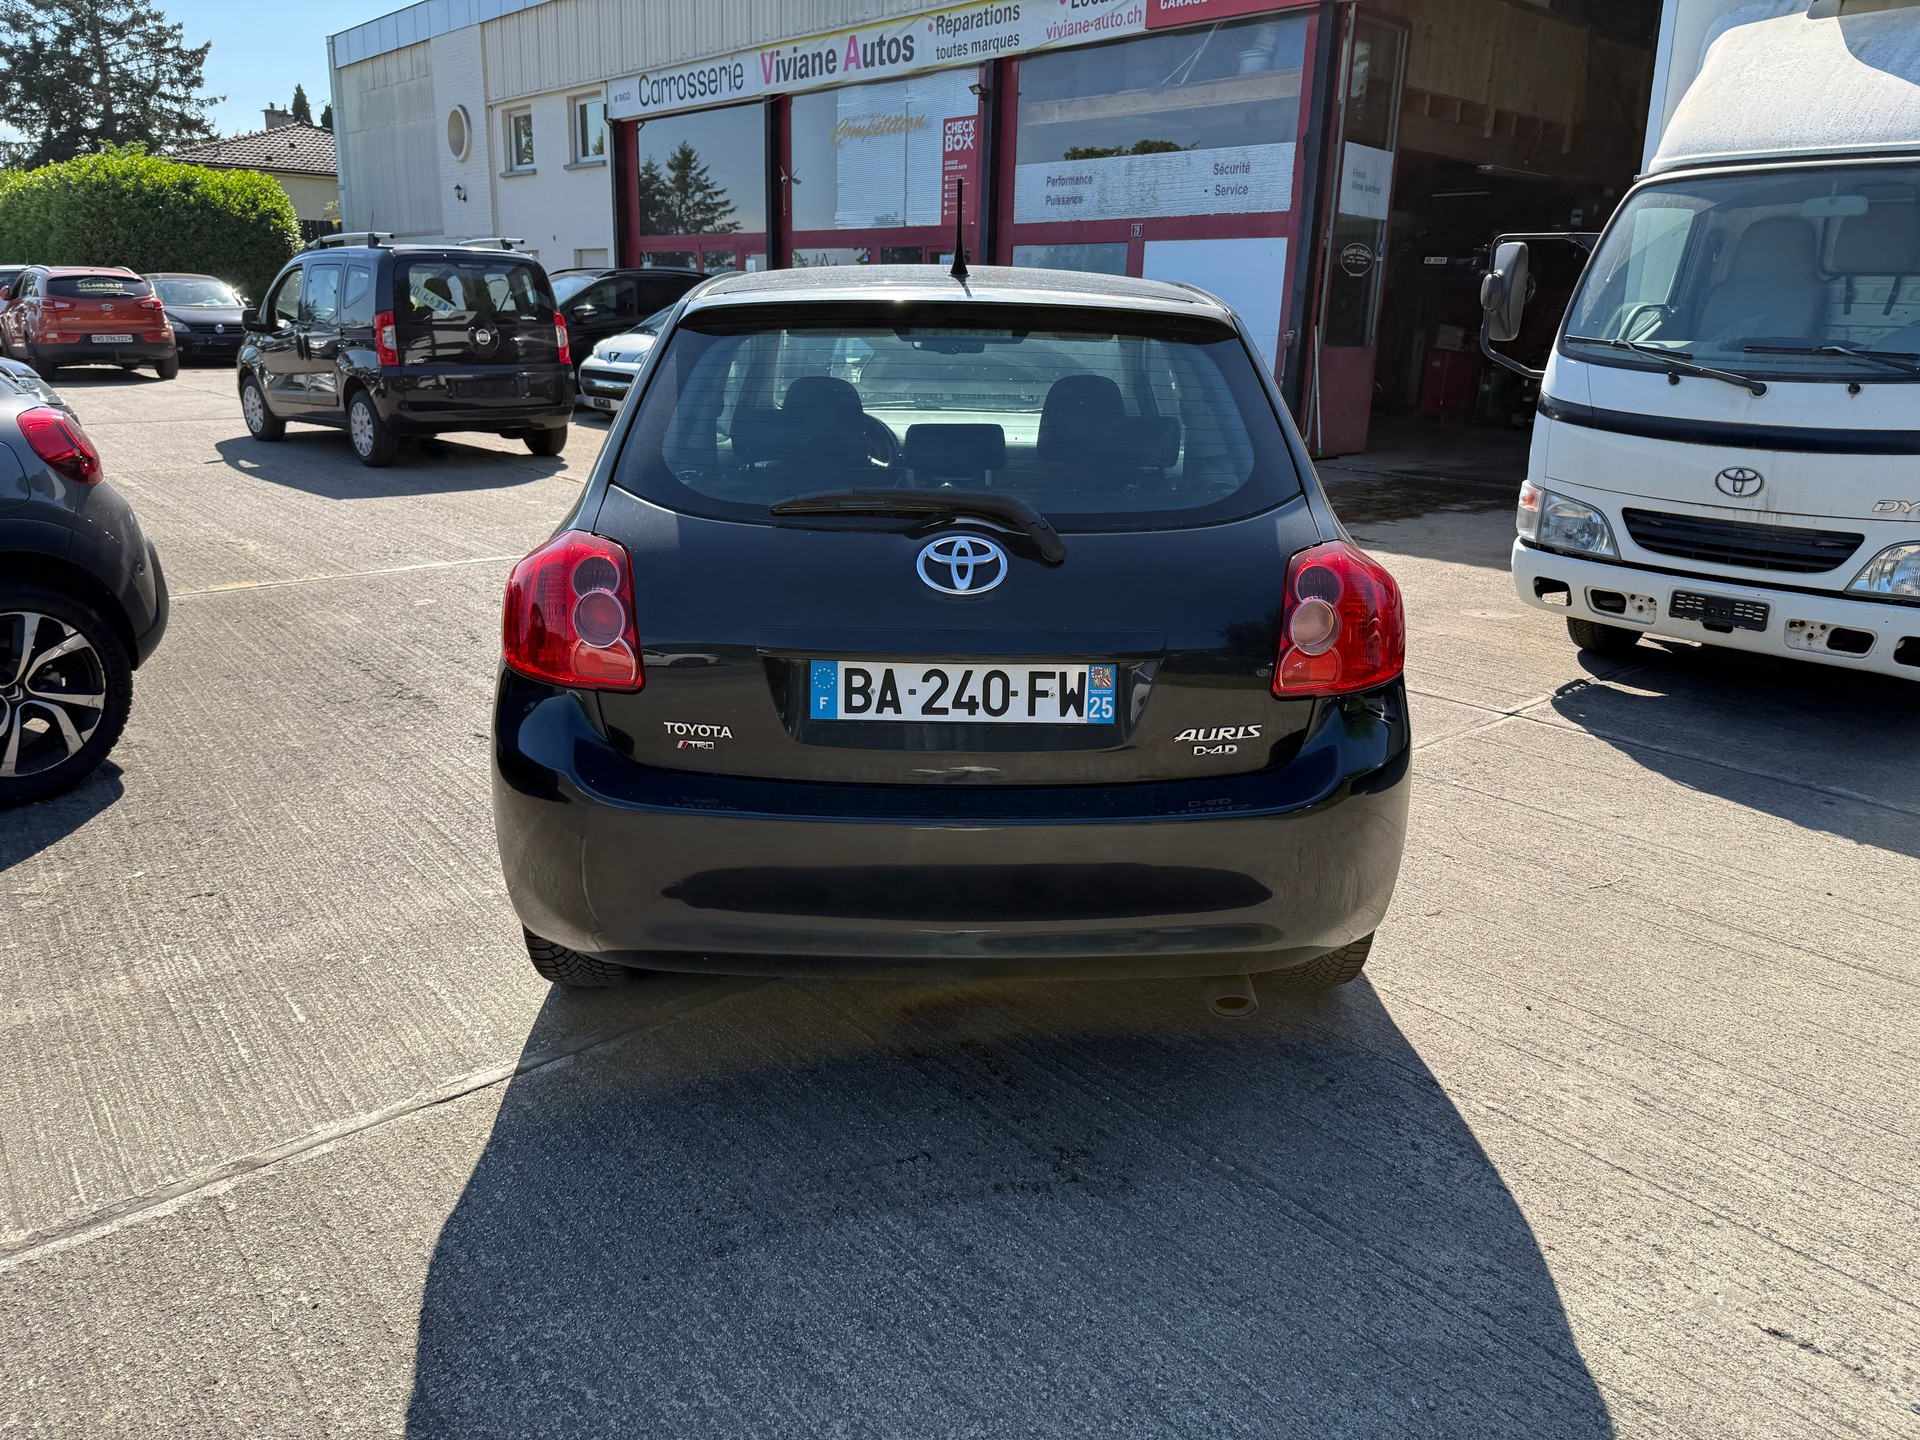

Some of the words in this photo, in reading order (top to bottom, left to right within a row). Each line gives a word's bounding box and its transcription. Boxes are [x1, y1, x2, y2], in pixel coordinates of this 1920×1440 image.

[936, 4, 1020, 38] Réparations
[1045, 5, 1143, 40] viviane-auto.ch
[936, 42, 968, 60] toutes
[971, 33, 1020, 54] marques
[760, 46, 837, 85] Viviane
[843, 33, 915, 72] Autos
[638, 62, 744, 107] Carrosserie
[945, 120, 975, 134] CHECK
[1213, 162, 1250, 175] Sécurité
[1046, 175, 1093, 187] Performance
[1214, 184, 1249, 197] Service
[1045, 195, 1083, 206] Puissance
[844, 667, 1087, 718] BA-240-FW
[819, 696, 829, 710] F
[1089, 696, 1113, 719] 25
[663, 721, 733, 739] TOYOTA
[1173, 724, 1263, 743] AURIS
[1193, 744, 1238, 756] D-4D
